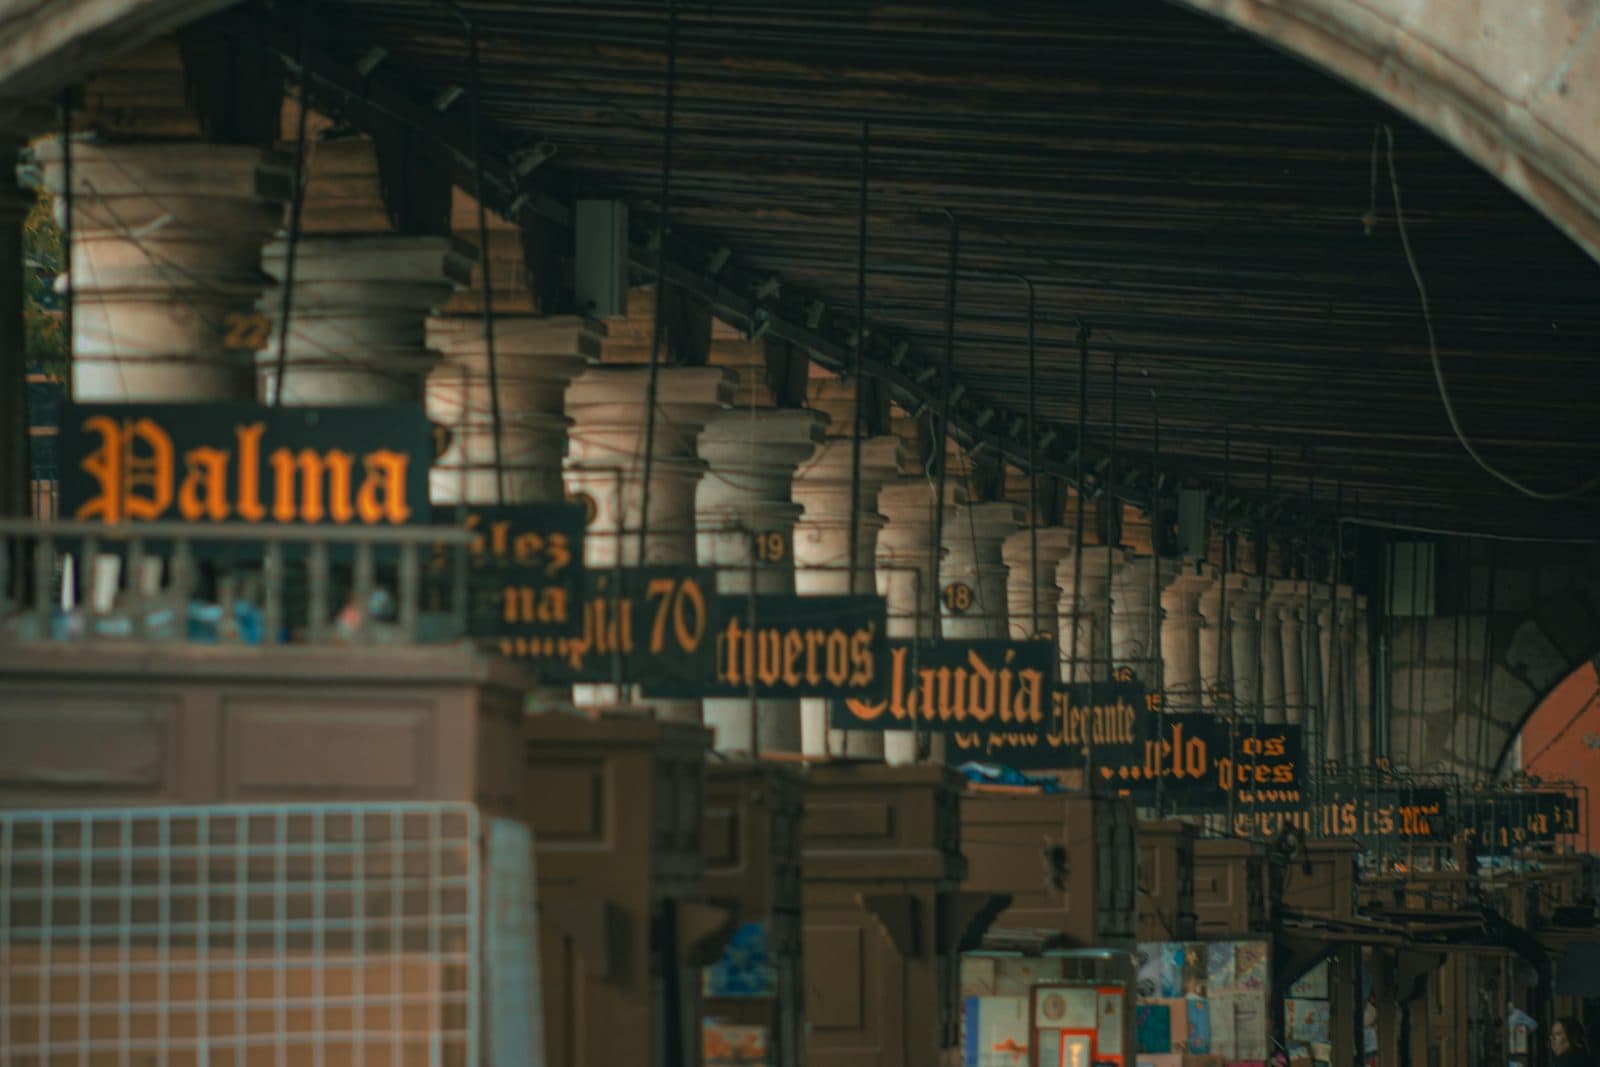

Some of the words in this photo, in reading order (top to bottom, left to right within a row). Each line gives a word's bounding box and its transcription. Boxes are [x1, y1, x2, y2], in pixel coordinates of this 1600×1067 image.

[224, 312, 269, 350] 22
[76, 415, 412, 526] Palma
[756, 533, 784, 561] 19
[648, 578, 705, 654] 70
[945, 584, 971, 610] 18
[845, 648, 1043, 724] laudia
